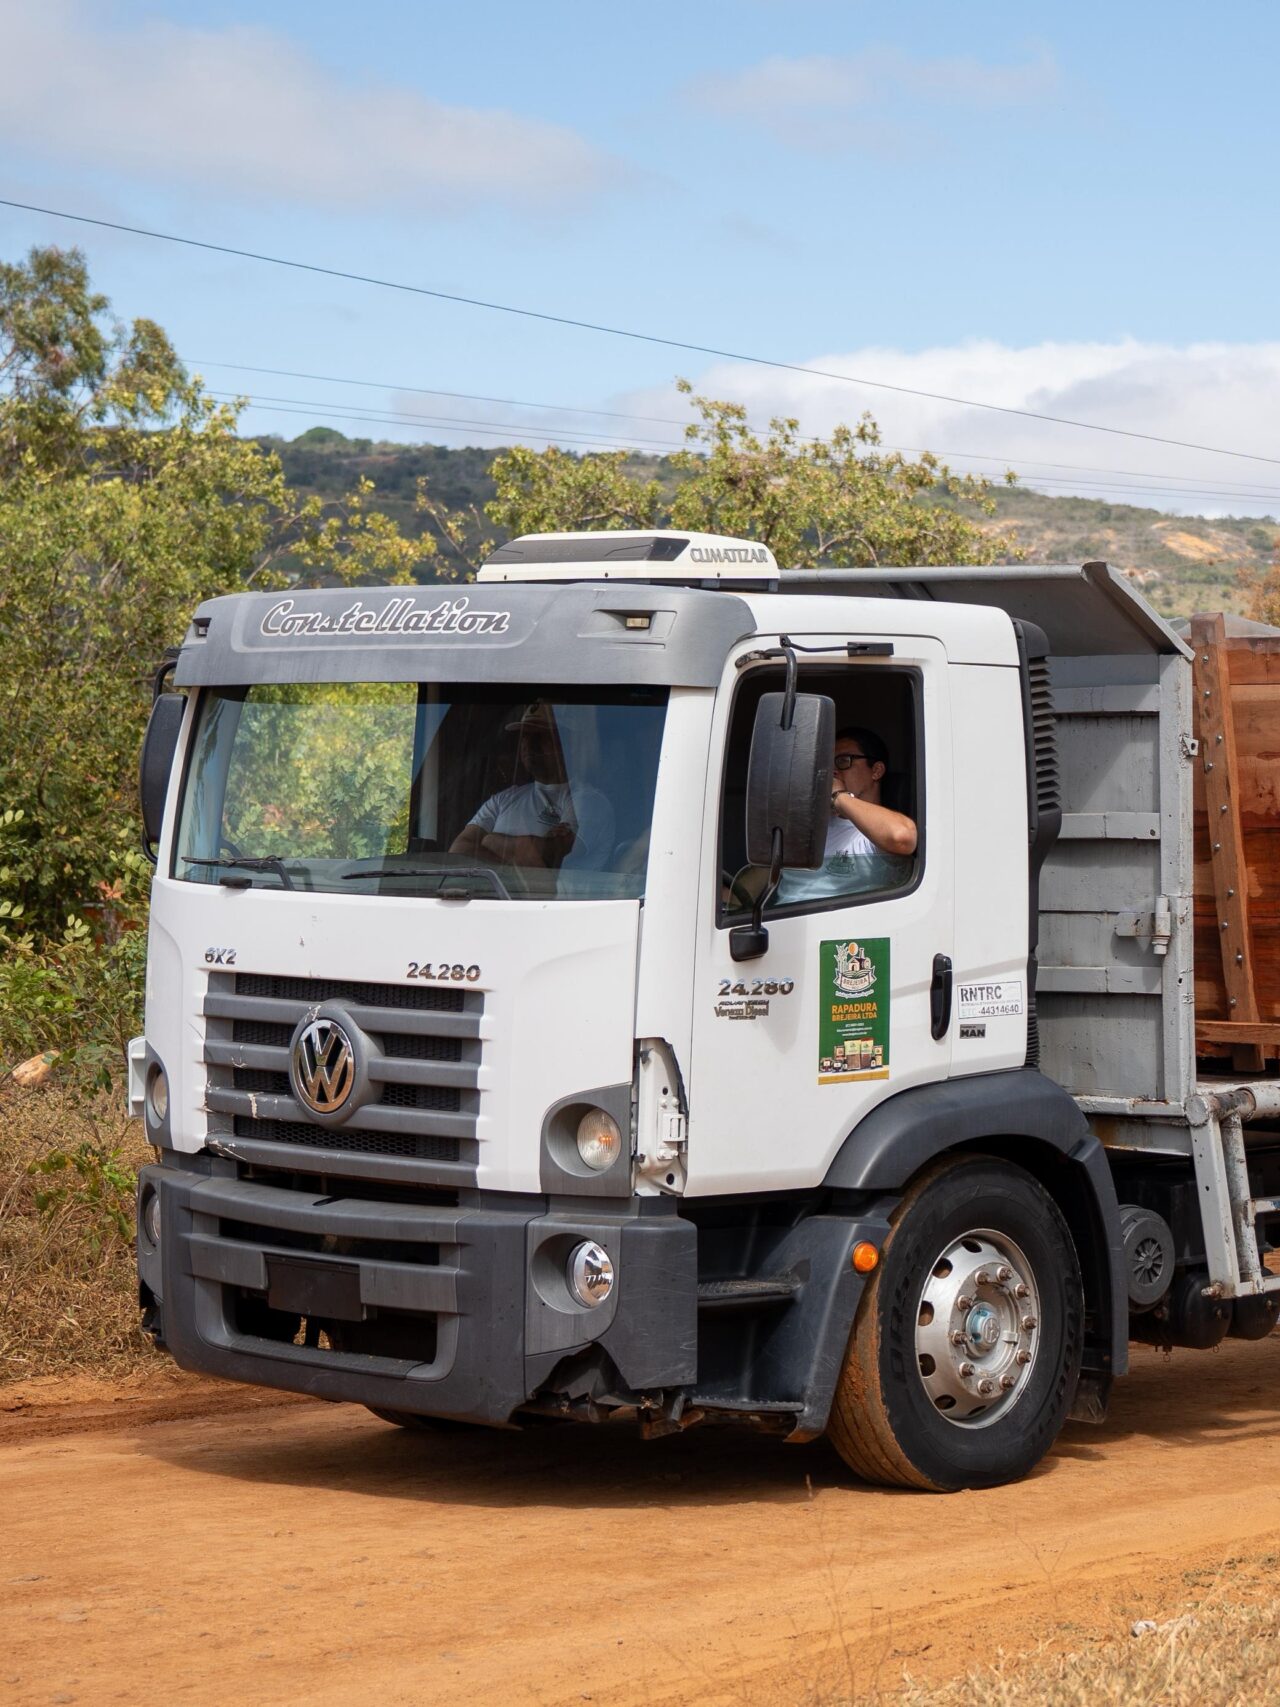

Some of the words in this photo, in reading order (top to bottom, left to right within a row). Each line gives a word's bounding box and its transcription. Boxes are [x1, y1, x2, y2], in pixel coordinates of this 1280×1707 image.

[690, 548, 768, 562] CLIMATIZAR
[260, 597, 511, 636] Constellation
[406, 962, 481, 982] 24.280
[717, 976, 794, 996] 24.280
[961, 986, 1002, 1002] RNTRC
[831, 1002, 878, 1014] RAPADURA
[831, 1013, 861, 1022] BREJEIRA
[862, 1011, 878, 1020] LTDA
[960, 1029, 986, 1038] MAN
